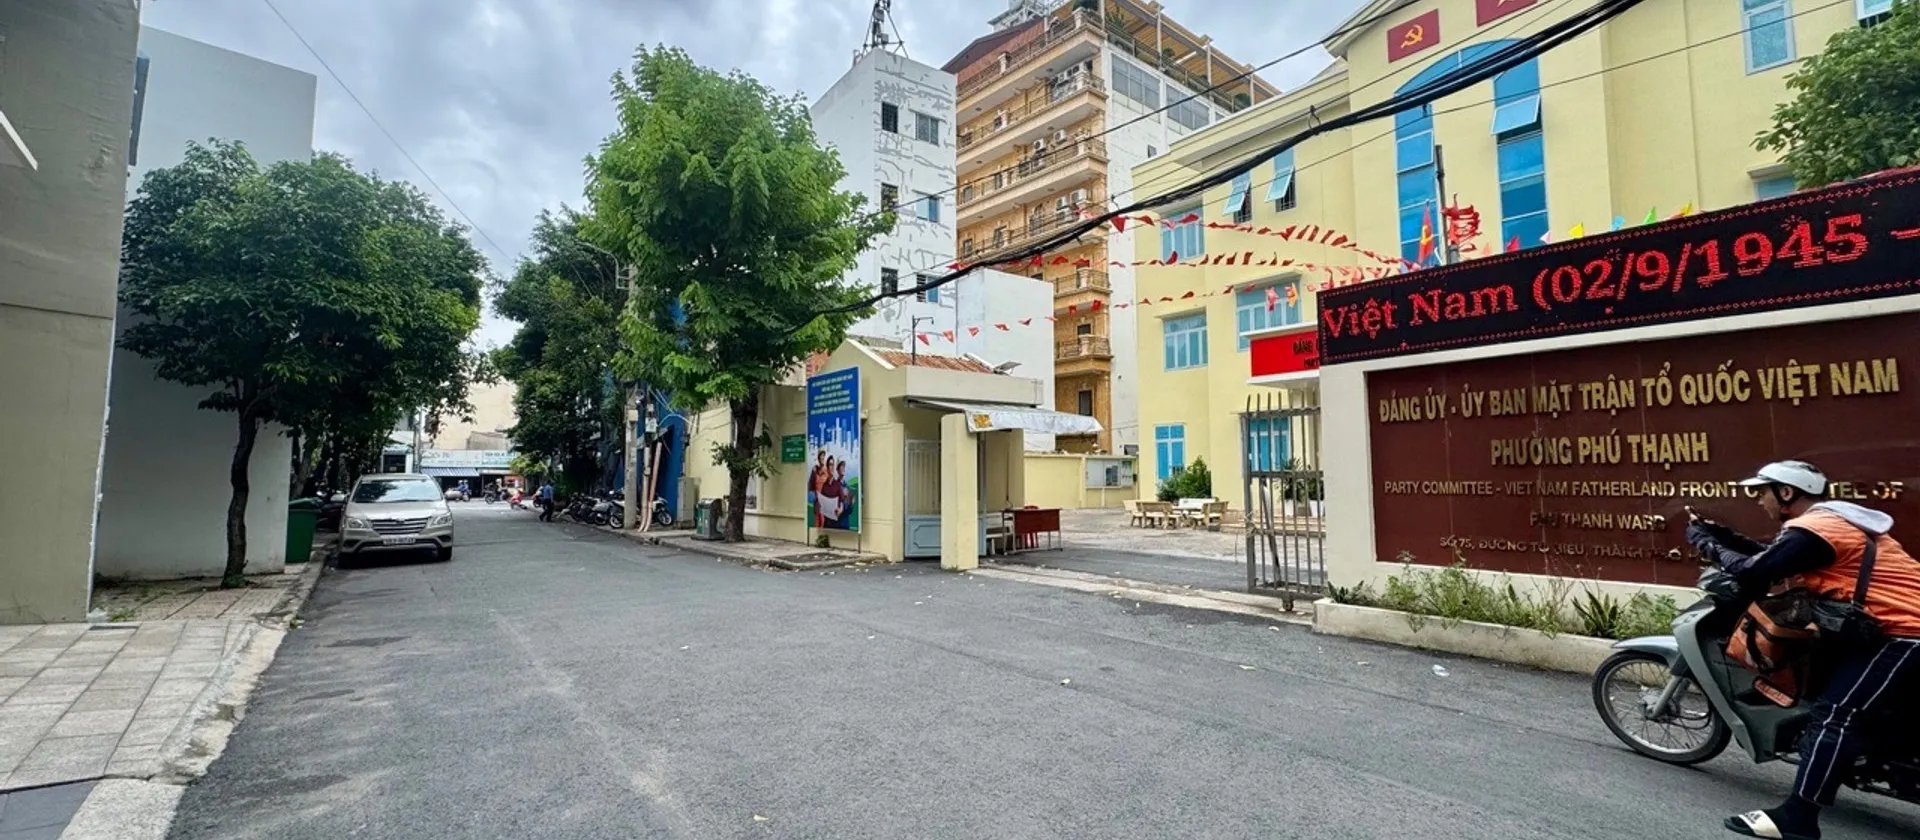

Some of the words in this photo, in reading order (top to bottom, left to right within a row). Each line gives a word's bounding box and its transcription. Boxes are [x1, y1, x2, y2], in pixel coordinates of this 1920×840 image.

[1323, 298, 1398, 339] Việt
[1408, 283, 1519, 326] Nam
[1532, 213, 1868, 311] (02/9/1945
[1424, 386, 1447, 420] ỦY
[1461, 383, 1485, 418] ỦY
[1490, 388, 1527, 416] BAN
[1532, 379, 1573, 419] MẶT
[1578, 373, 1636, 416] TRẬN
[1642, 361, 1673, 406] TỔ
[1679, 359, 1751, 407] QUỐC
[1757, 358, 1820, 406] VIỆT
[1829, 357, 1900, 396] NAM
[1578, 428, 1622, 465] PHÚ
[1627, 432, 1710, 471] THẠNH
[1384, 480, 1421, 494] PARTY
[1422, 480, 1493, 495] COMMITTEE
[1504, 480, 1533, 495] VIET
[1538, 480, 1568, 496] NAM
[1572, 480, 1676, 497] FATHERLAND
[1680, 481, 1737, 498] FRONT
[1872, 481, 1904, 499] OF
[1561, 511, 1613, 529] THANH
